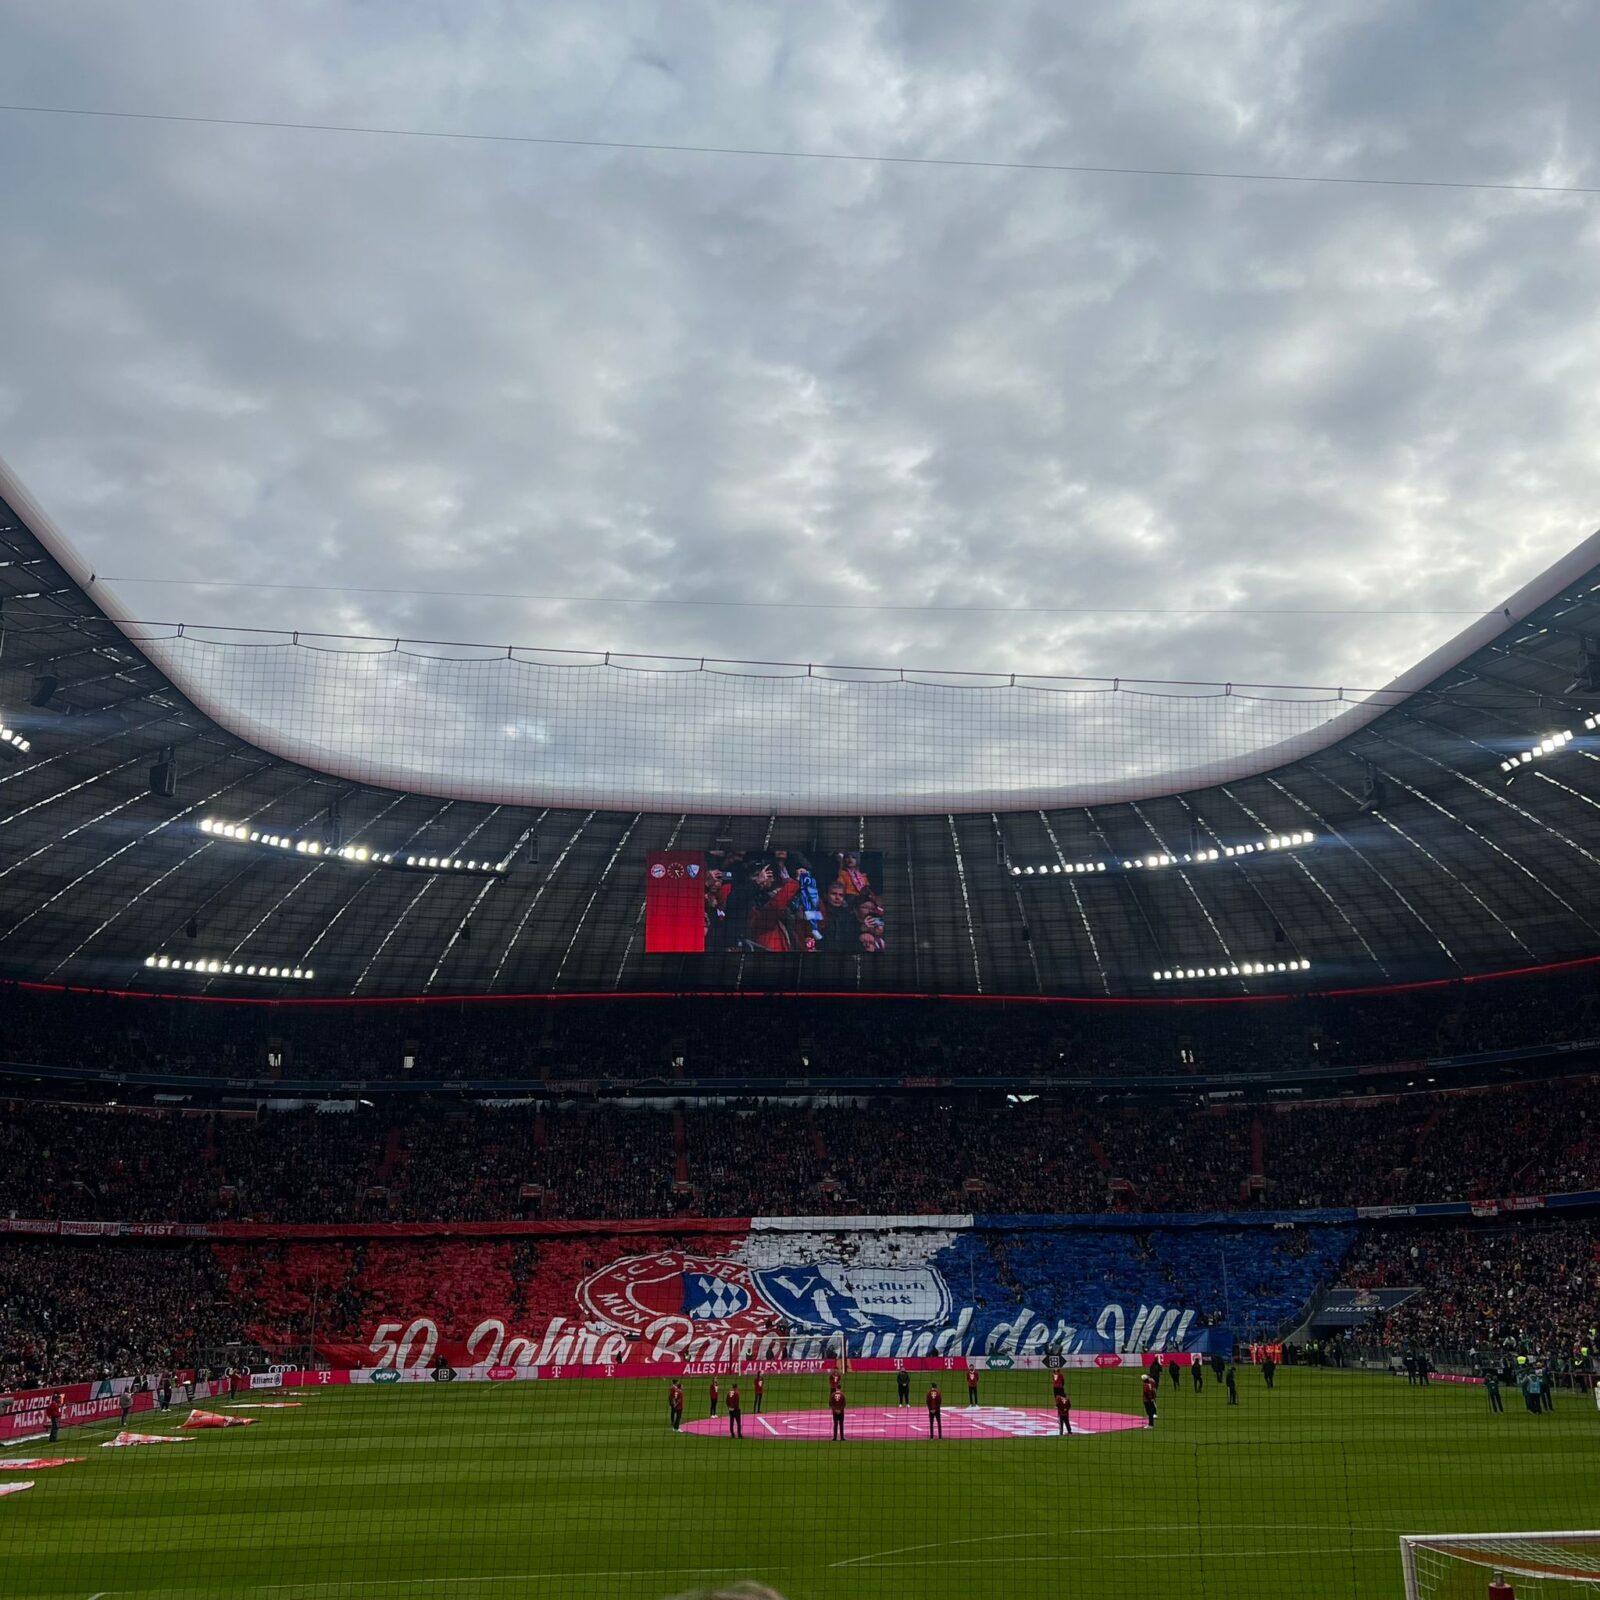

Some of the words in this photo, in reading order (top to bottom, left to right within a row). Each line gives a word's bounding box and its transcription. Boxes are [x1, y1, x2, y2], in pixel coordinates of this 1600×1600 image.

[144, 1225, 175, 1235] KIST
[368, 1317, 439, 1369] 50
[466, 1316, 630, 1368] Jahre
[682, 1362, 716, 1375] ALLES
[744, 1361, 777, 1373] ALLES
[252, 1375, 273, 1385] Allianz
